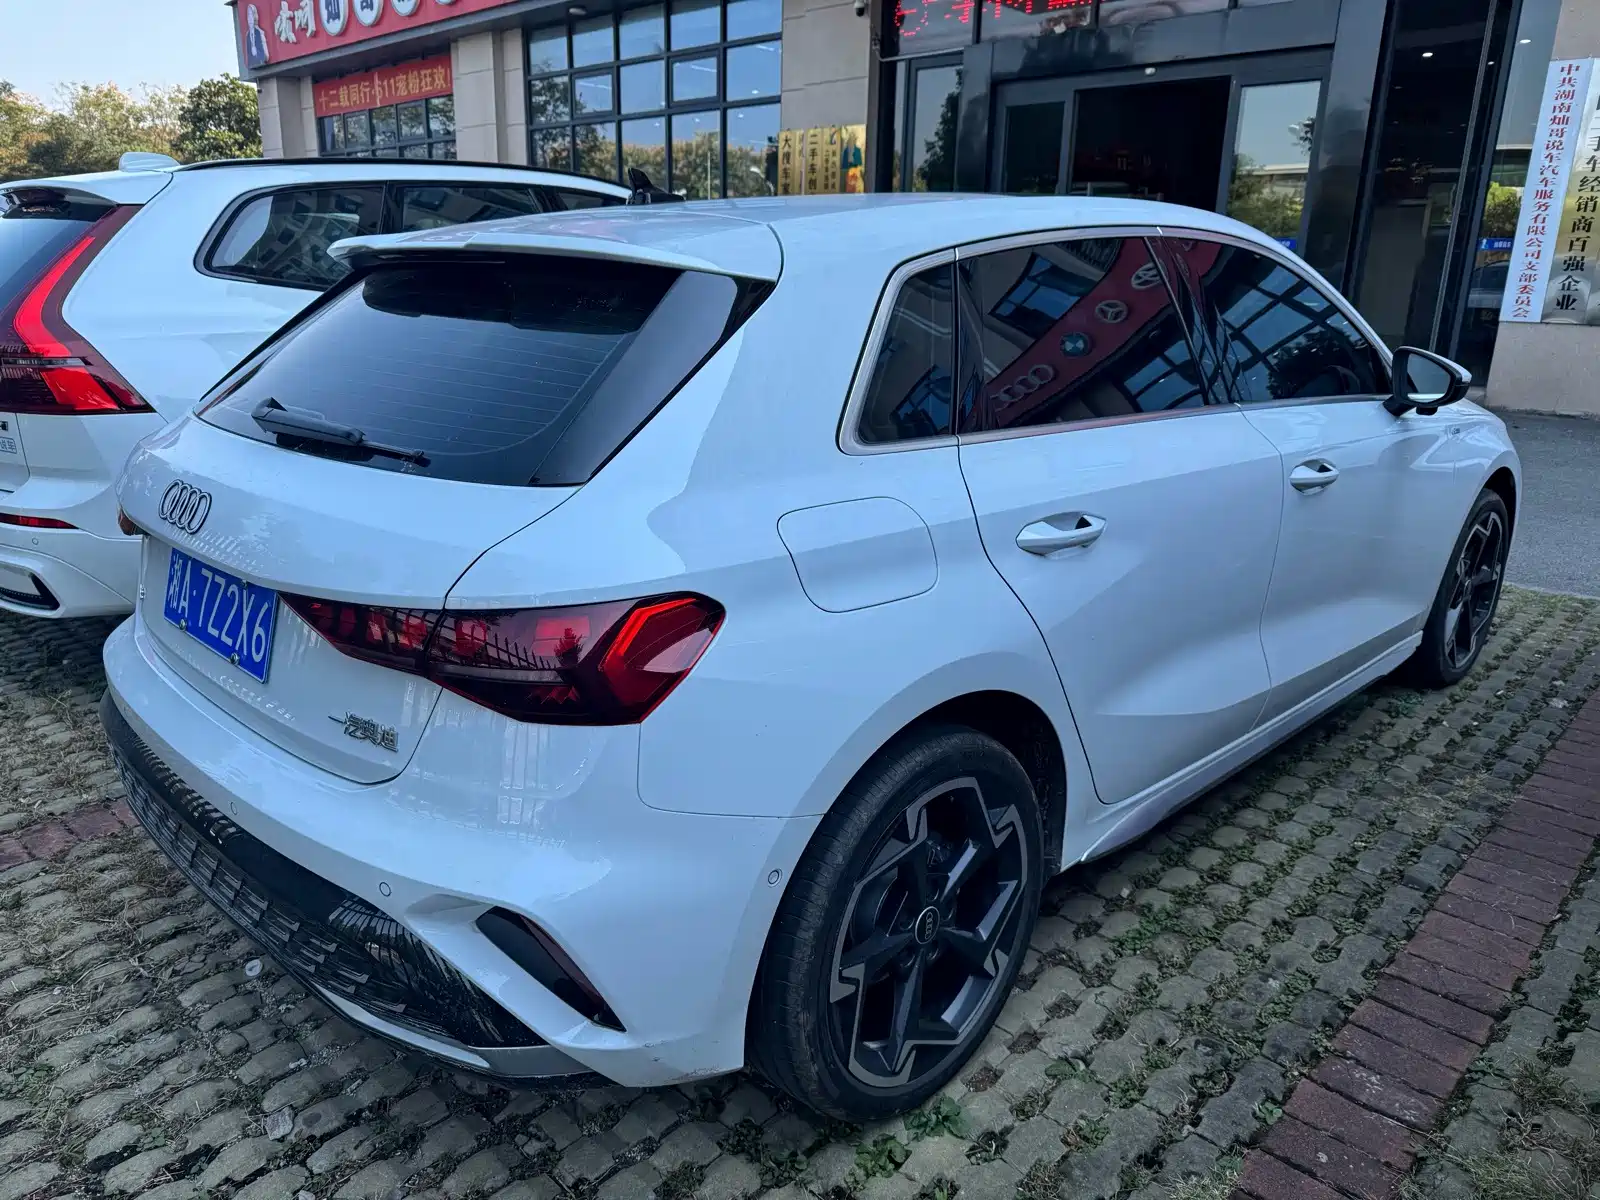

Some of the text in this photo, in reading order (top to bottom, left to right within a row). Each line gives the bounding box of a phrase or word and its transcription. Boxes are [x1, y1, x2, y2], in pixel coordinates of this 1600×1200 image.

[1513, 64, 1580, 317] 中共湖南灿哥说车汽车服务有限公司支部委员会
[328, 711, 399, 753] 一汽奥迪
